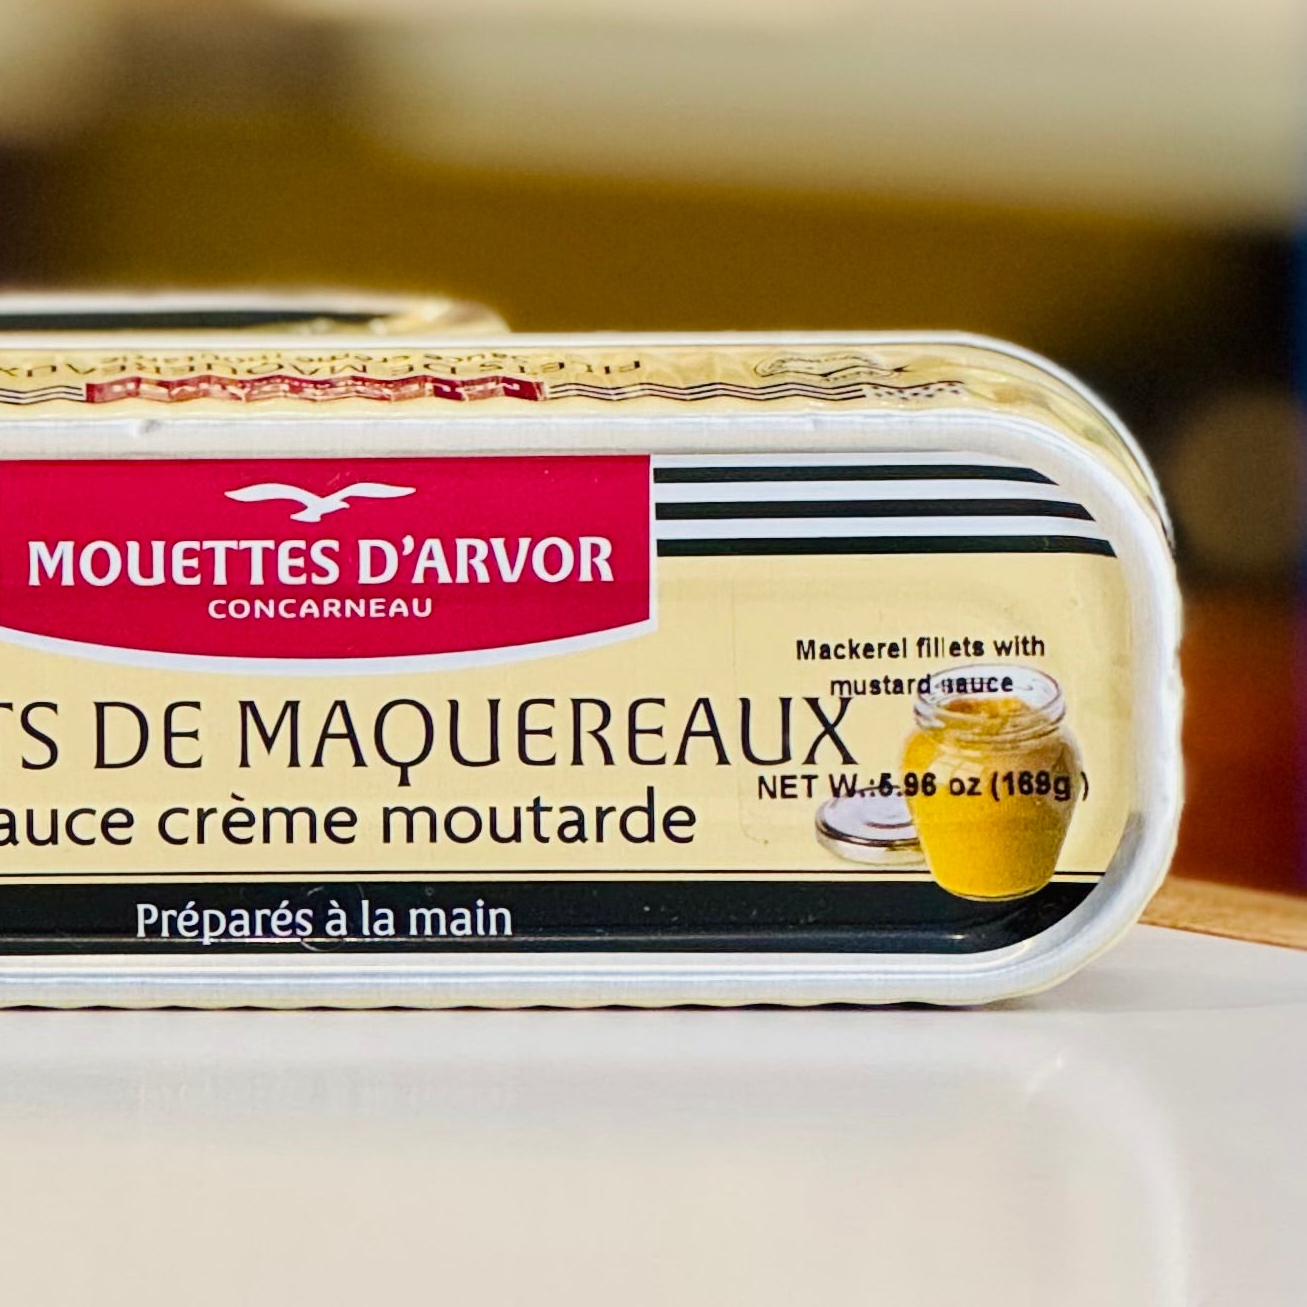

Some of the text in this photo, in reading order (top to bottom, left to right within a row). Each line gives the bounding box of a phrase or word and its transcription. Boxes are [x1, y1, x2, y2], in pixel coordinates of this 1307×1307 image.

[27, 535, 614, 588] MOUETTES D'ARVOR
[207, 598, 433, 620] CONCARNEAU
[796, 637, 908, 660] Mackerel
[993, 635, 1046, 657] with
[830, 674, 1014, 696] mustard sauce
[93, 700, 203, 770] DE
[237, 696, 860, 787] MAQUEREAUX
[758, 774, 819, 799] NET
[950, 777, 983, 796] oz
[158, 792, 359, 846] crème
[382, 786, 697, 845] moutarde
[136, 899, 513, 946] Préparés à la main
